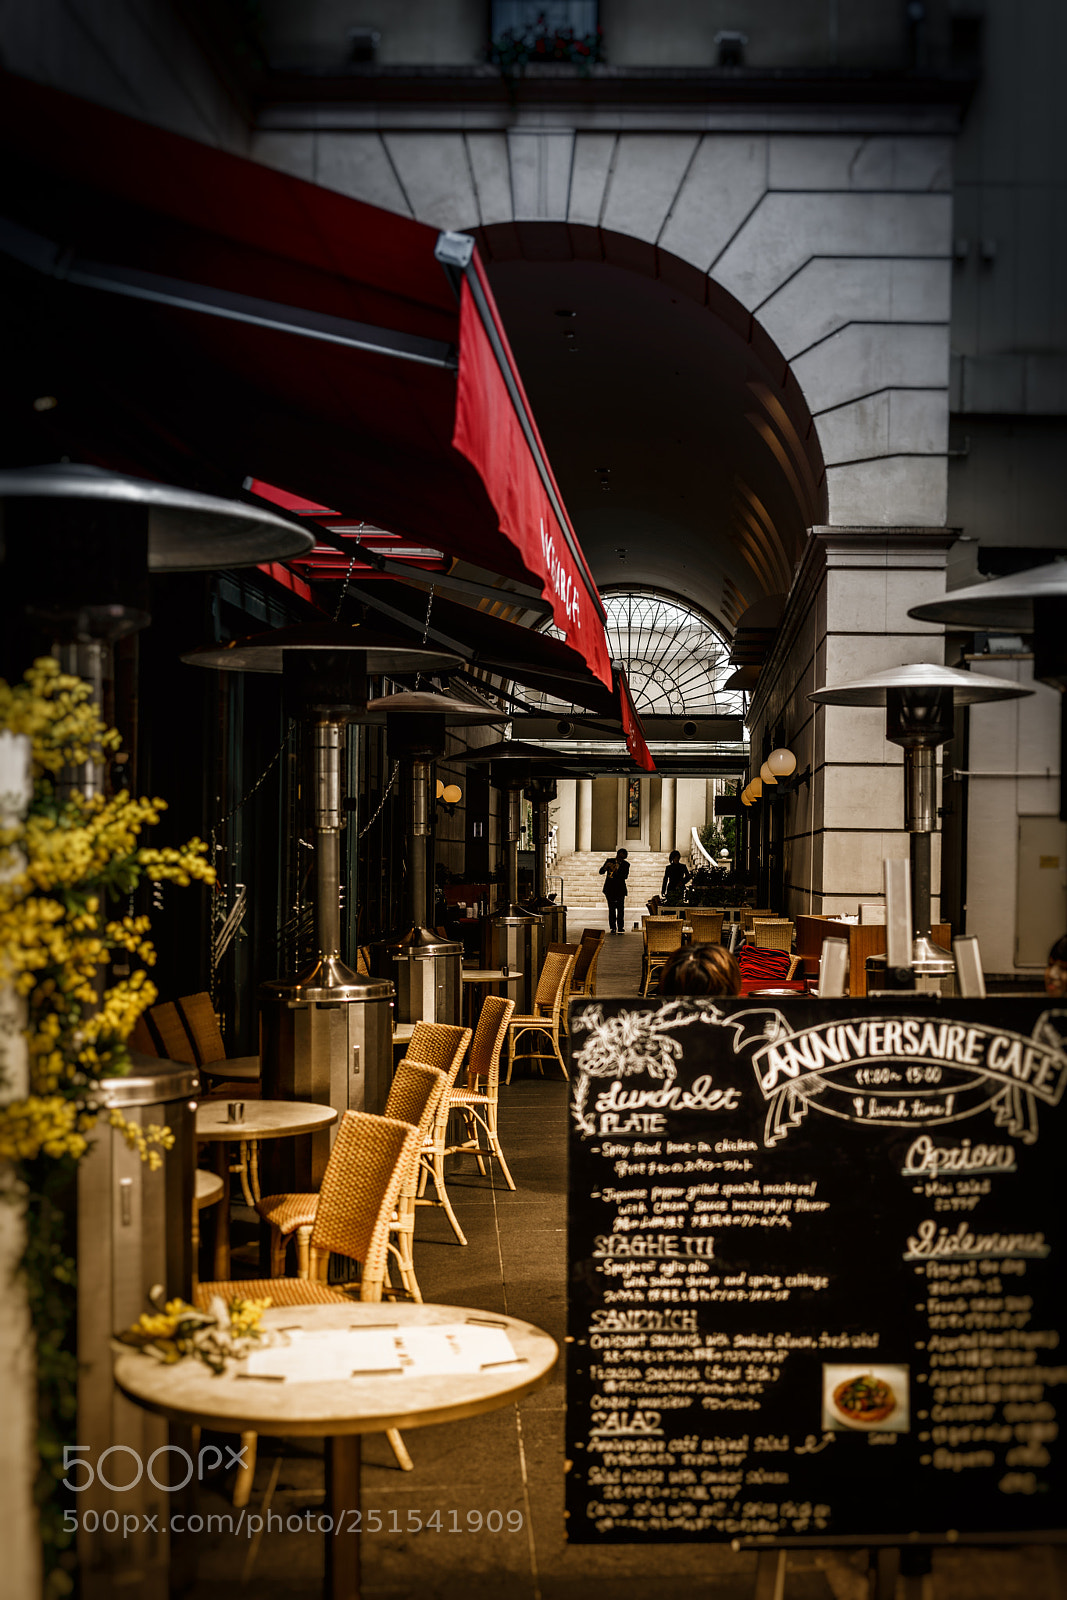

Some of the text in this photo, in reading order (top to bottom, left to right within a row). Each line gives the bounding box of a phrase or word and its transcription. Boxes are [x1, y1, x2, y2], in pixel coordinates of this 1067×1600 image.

[761, 1020, 985, 1090] ANNIVERSAIRE
[600, 1112, 668, 1134] PLATE
[723, 1271, 747, 1286] and
